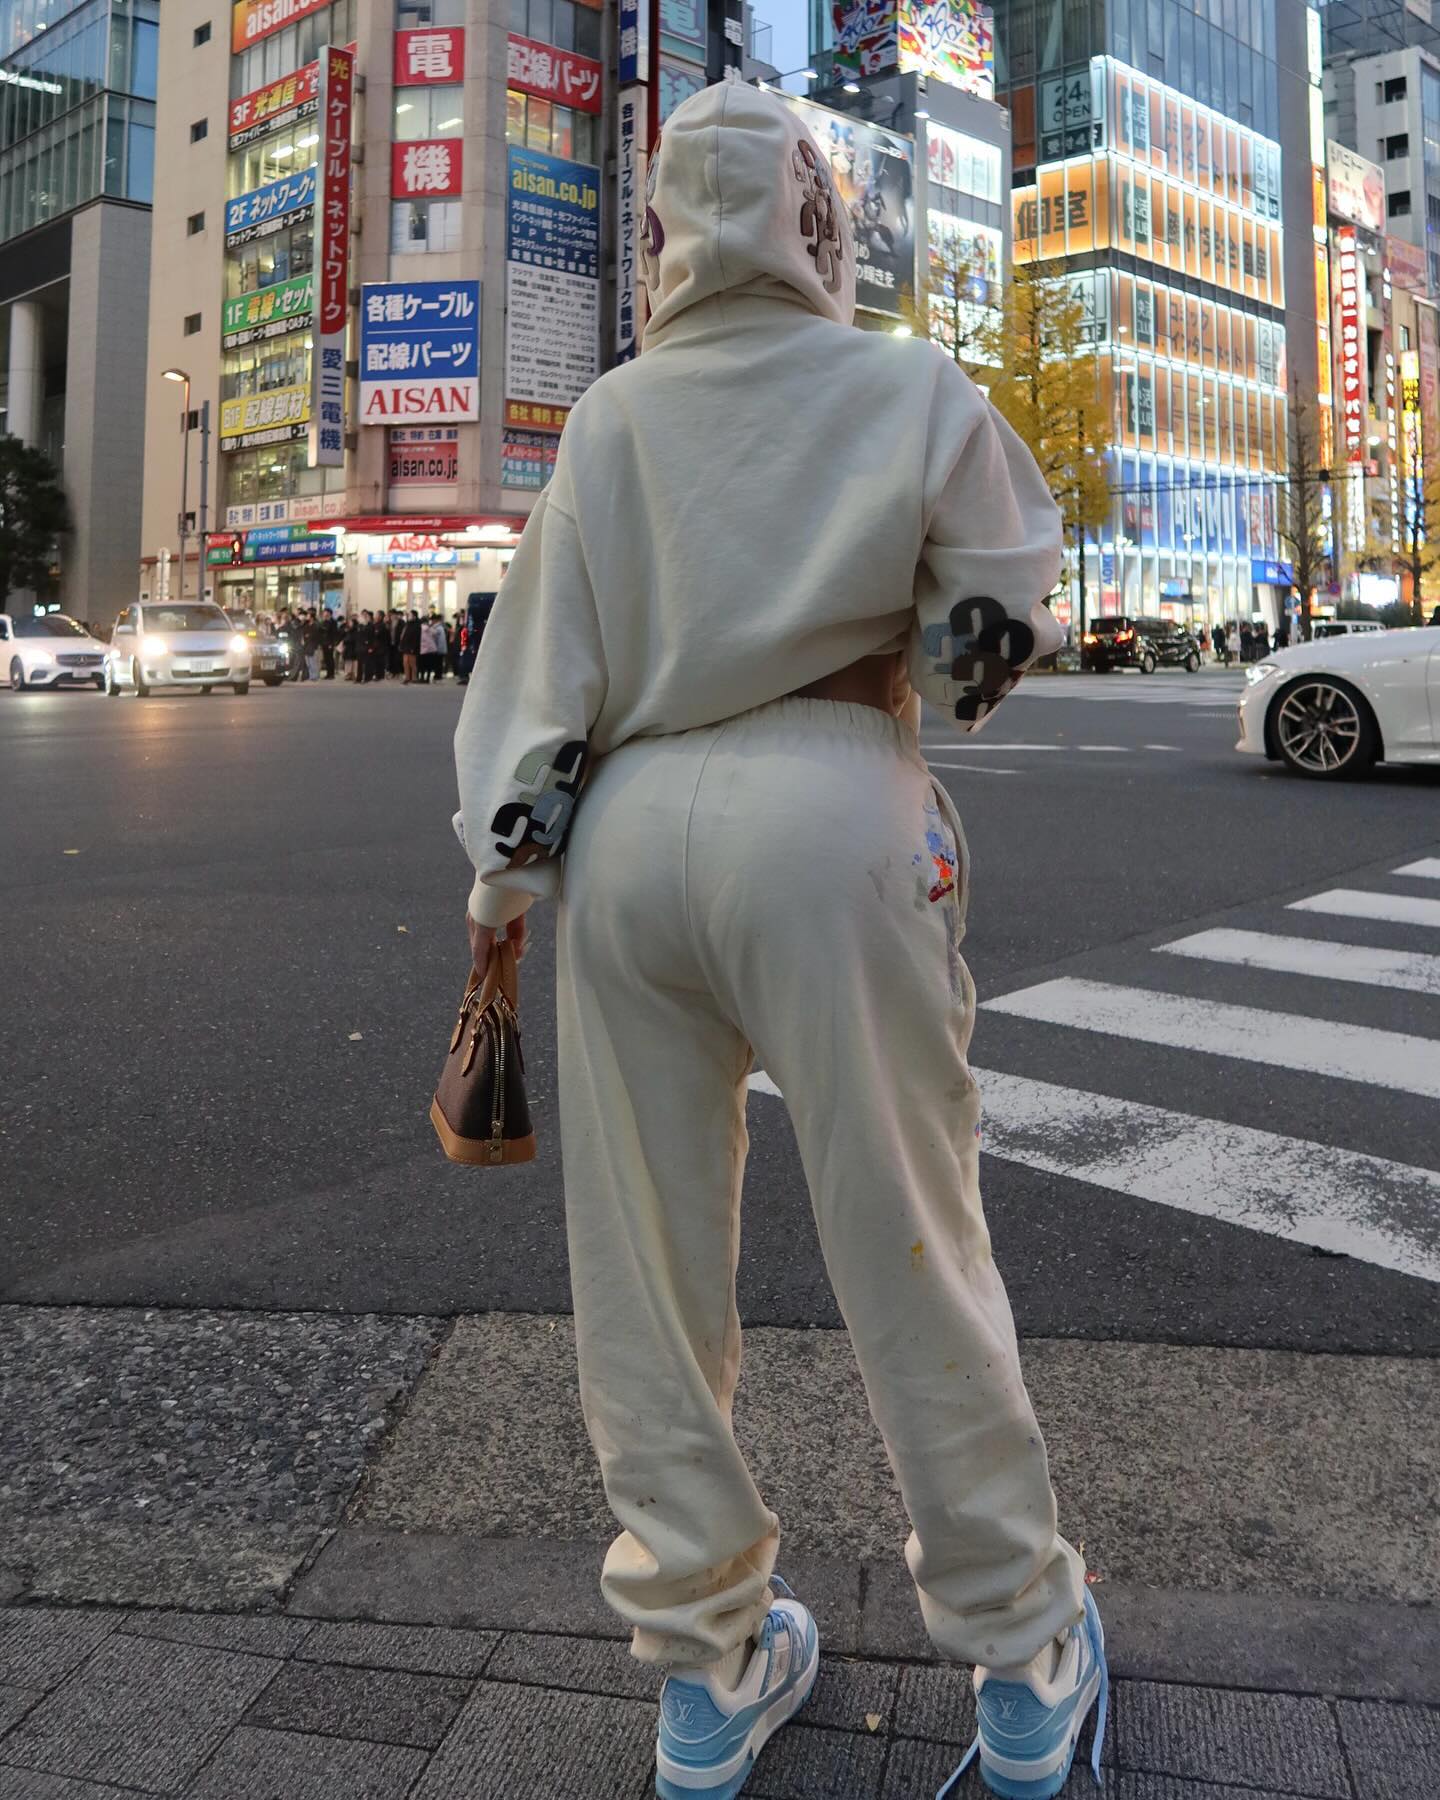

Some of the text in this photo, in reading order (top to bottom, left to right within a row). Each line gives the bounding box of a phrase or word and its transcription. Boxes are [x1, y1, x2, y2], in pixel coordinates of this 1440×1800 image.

[507, 41, 599, 101] 配線パーツ
[232, 101, 251, 126] 3F
[403, 33, 453, 192] 電 機
[1052, 105, 1092, 123] OPEN
[512, 166, 598, 210] aisan.co.jp
[229, 201, 248, 226] 2F
[1017, 190, 1089, 242] 個室
[227, 303, 244, 326] 1F
[367, 291, 475, 323] 各種ケーブル
[366, 341, 472, 371] 配線パーツ
[321, 347, 343, 451] 愛三電機
[365, 386, 472, 415] AISAN
